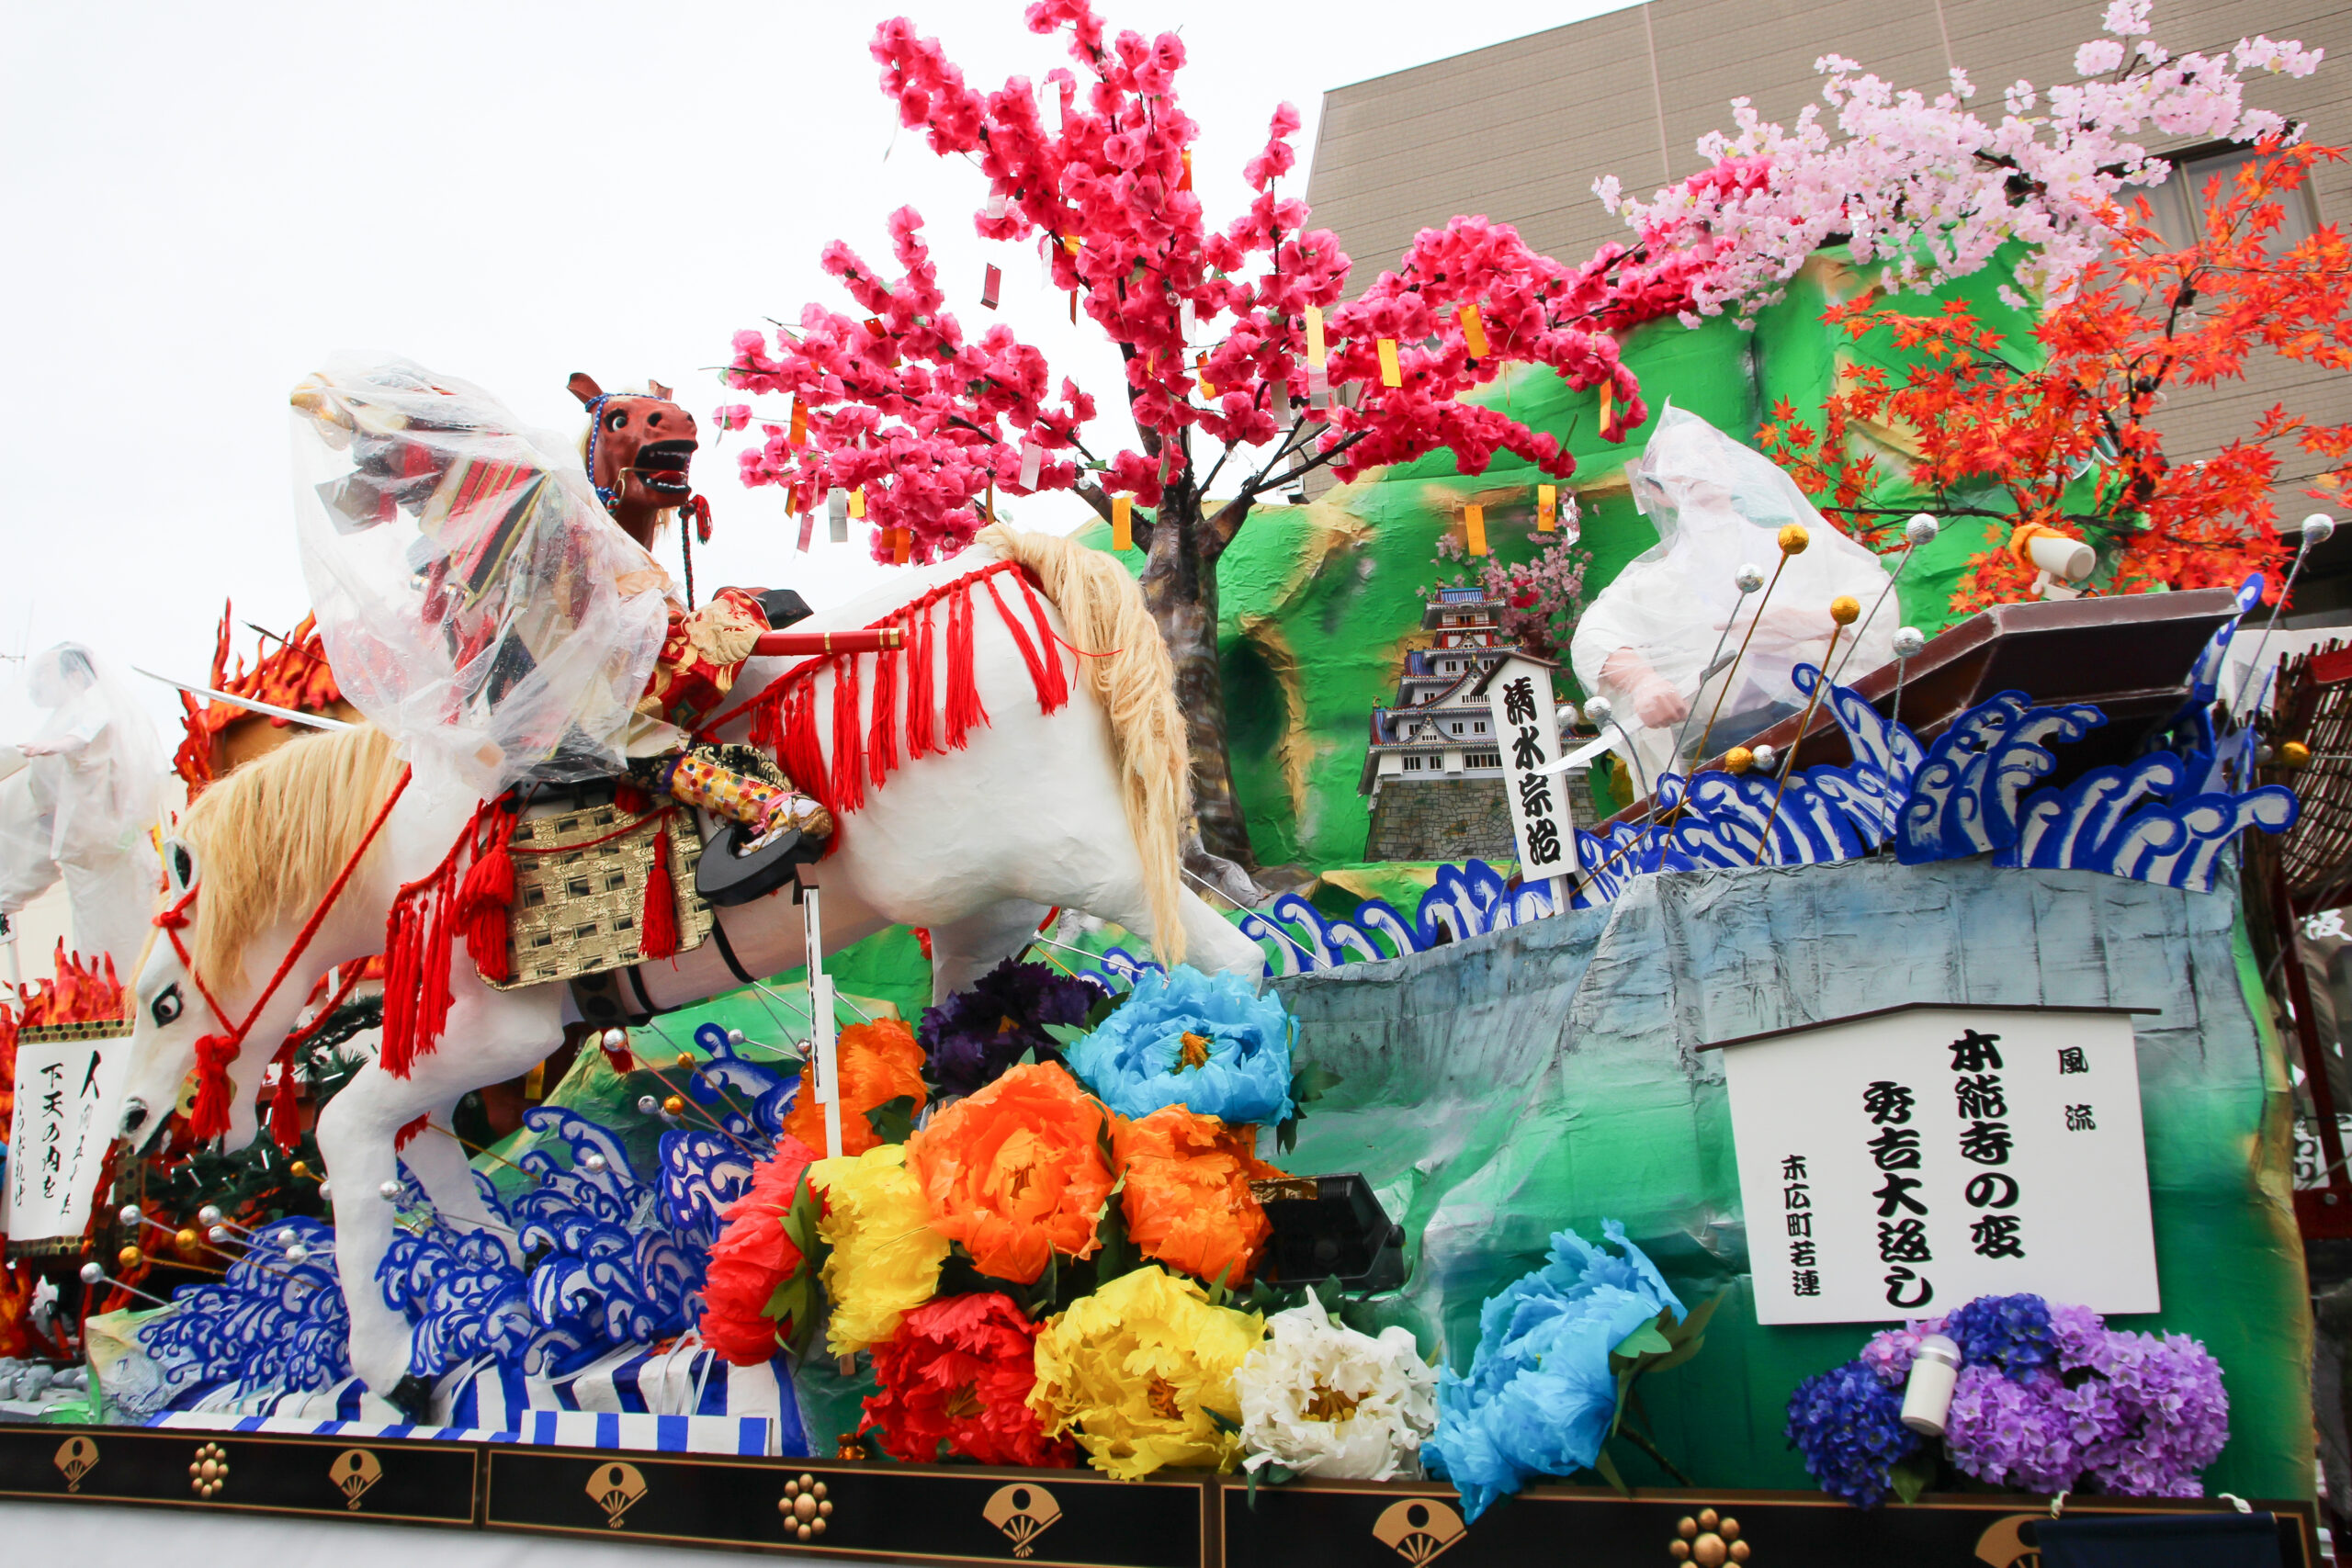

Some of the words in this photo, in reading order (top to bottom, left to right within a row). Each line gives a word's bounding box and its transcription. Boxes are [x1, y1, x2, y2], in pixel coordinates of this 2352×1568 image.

[1502, 676, 1561, 866] 清水宗治
[40, 1063, 64, 1199] 下天の内を
[1948, 1028, 2026, 1259] 本能寺の変
[2057, 1046, 2097, 1132] 風流
[1781, 1154, 1821, 1297] 末広町若連
[1862, 1080, 1933, 1309] 秀吉大返し
